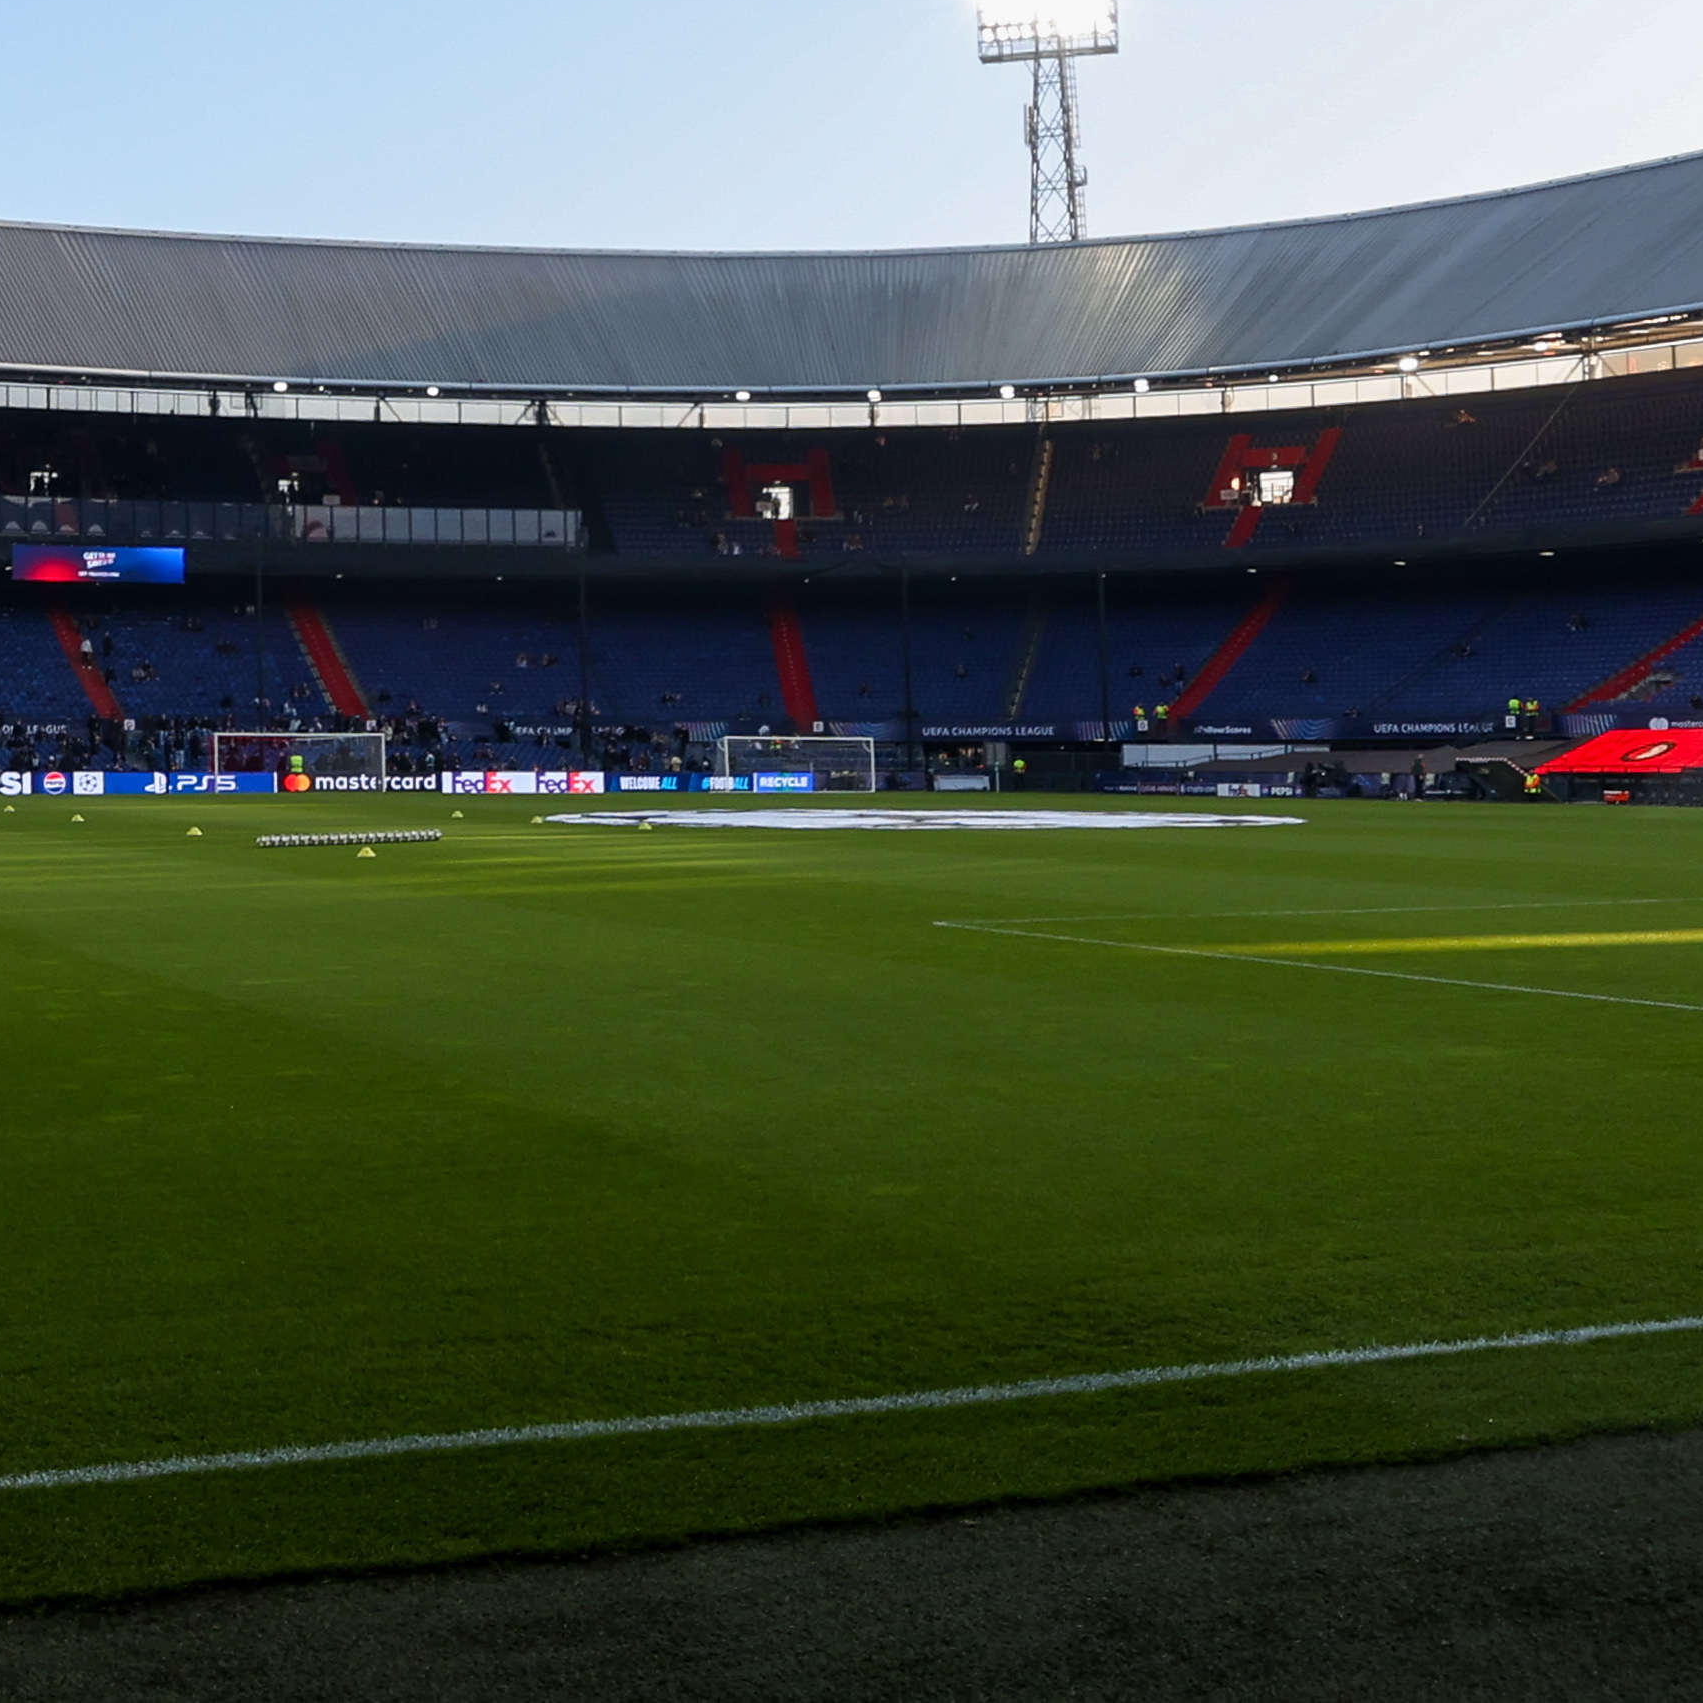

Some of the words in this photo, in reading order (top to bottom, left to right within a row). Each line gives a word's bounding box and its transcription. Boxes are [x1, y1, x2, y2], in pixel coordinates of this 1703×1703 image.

[922, 727, 949, 736] UEFA
[952, 727, 1012, 736] CHAMPIONS
[1015, 726, 1054, 736] LEAGUE
[1374, 723, 1398, 733] UEFA
[1401, 723, 1456, 734] CHAMPIONS
[177, 775, 238, 791] PS5
[315, 773, 436, 790] mastercard
[454, 772, 512, 793] FedEx
[537, 772, 596, 793] FedEx
[620, 776, 660, 790] WELCOME
[660, 776, 677, 790] ALL
[759, 777, 809, 788] RECYCLE
